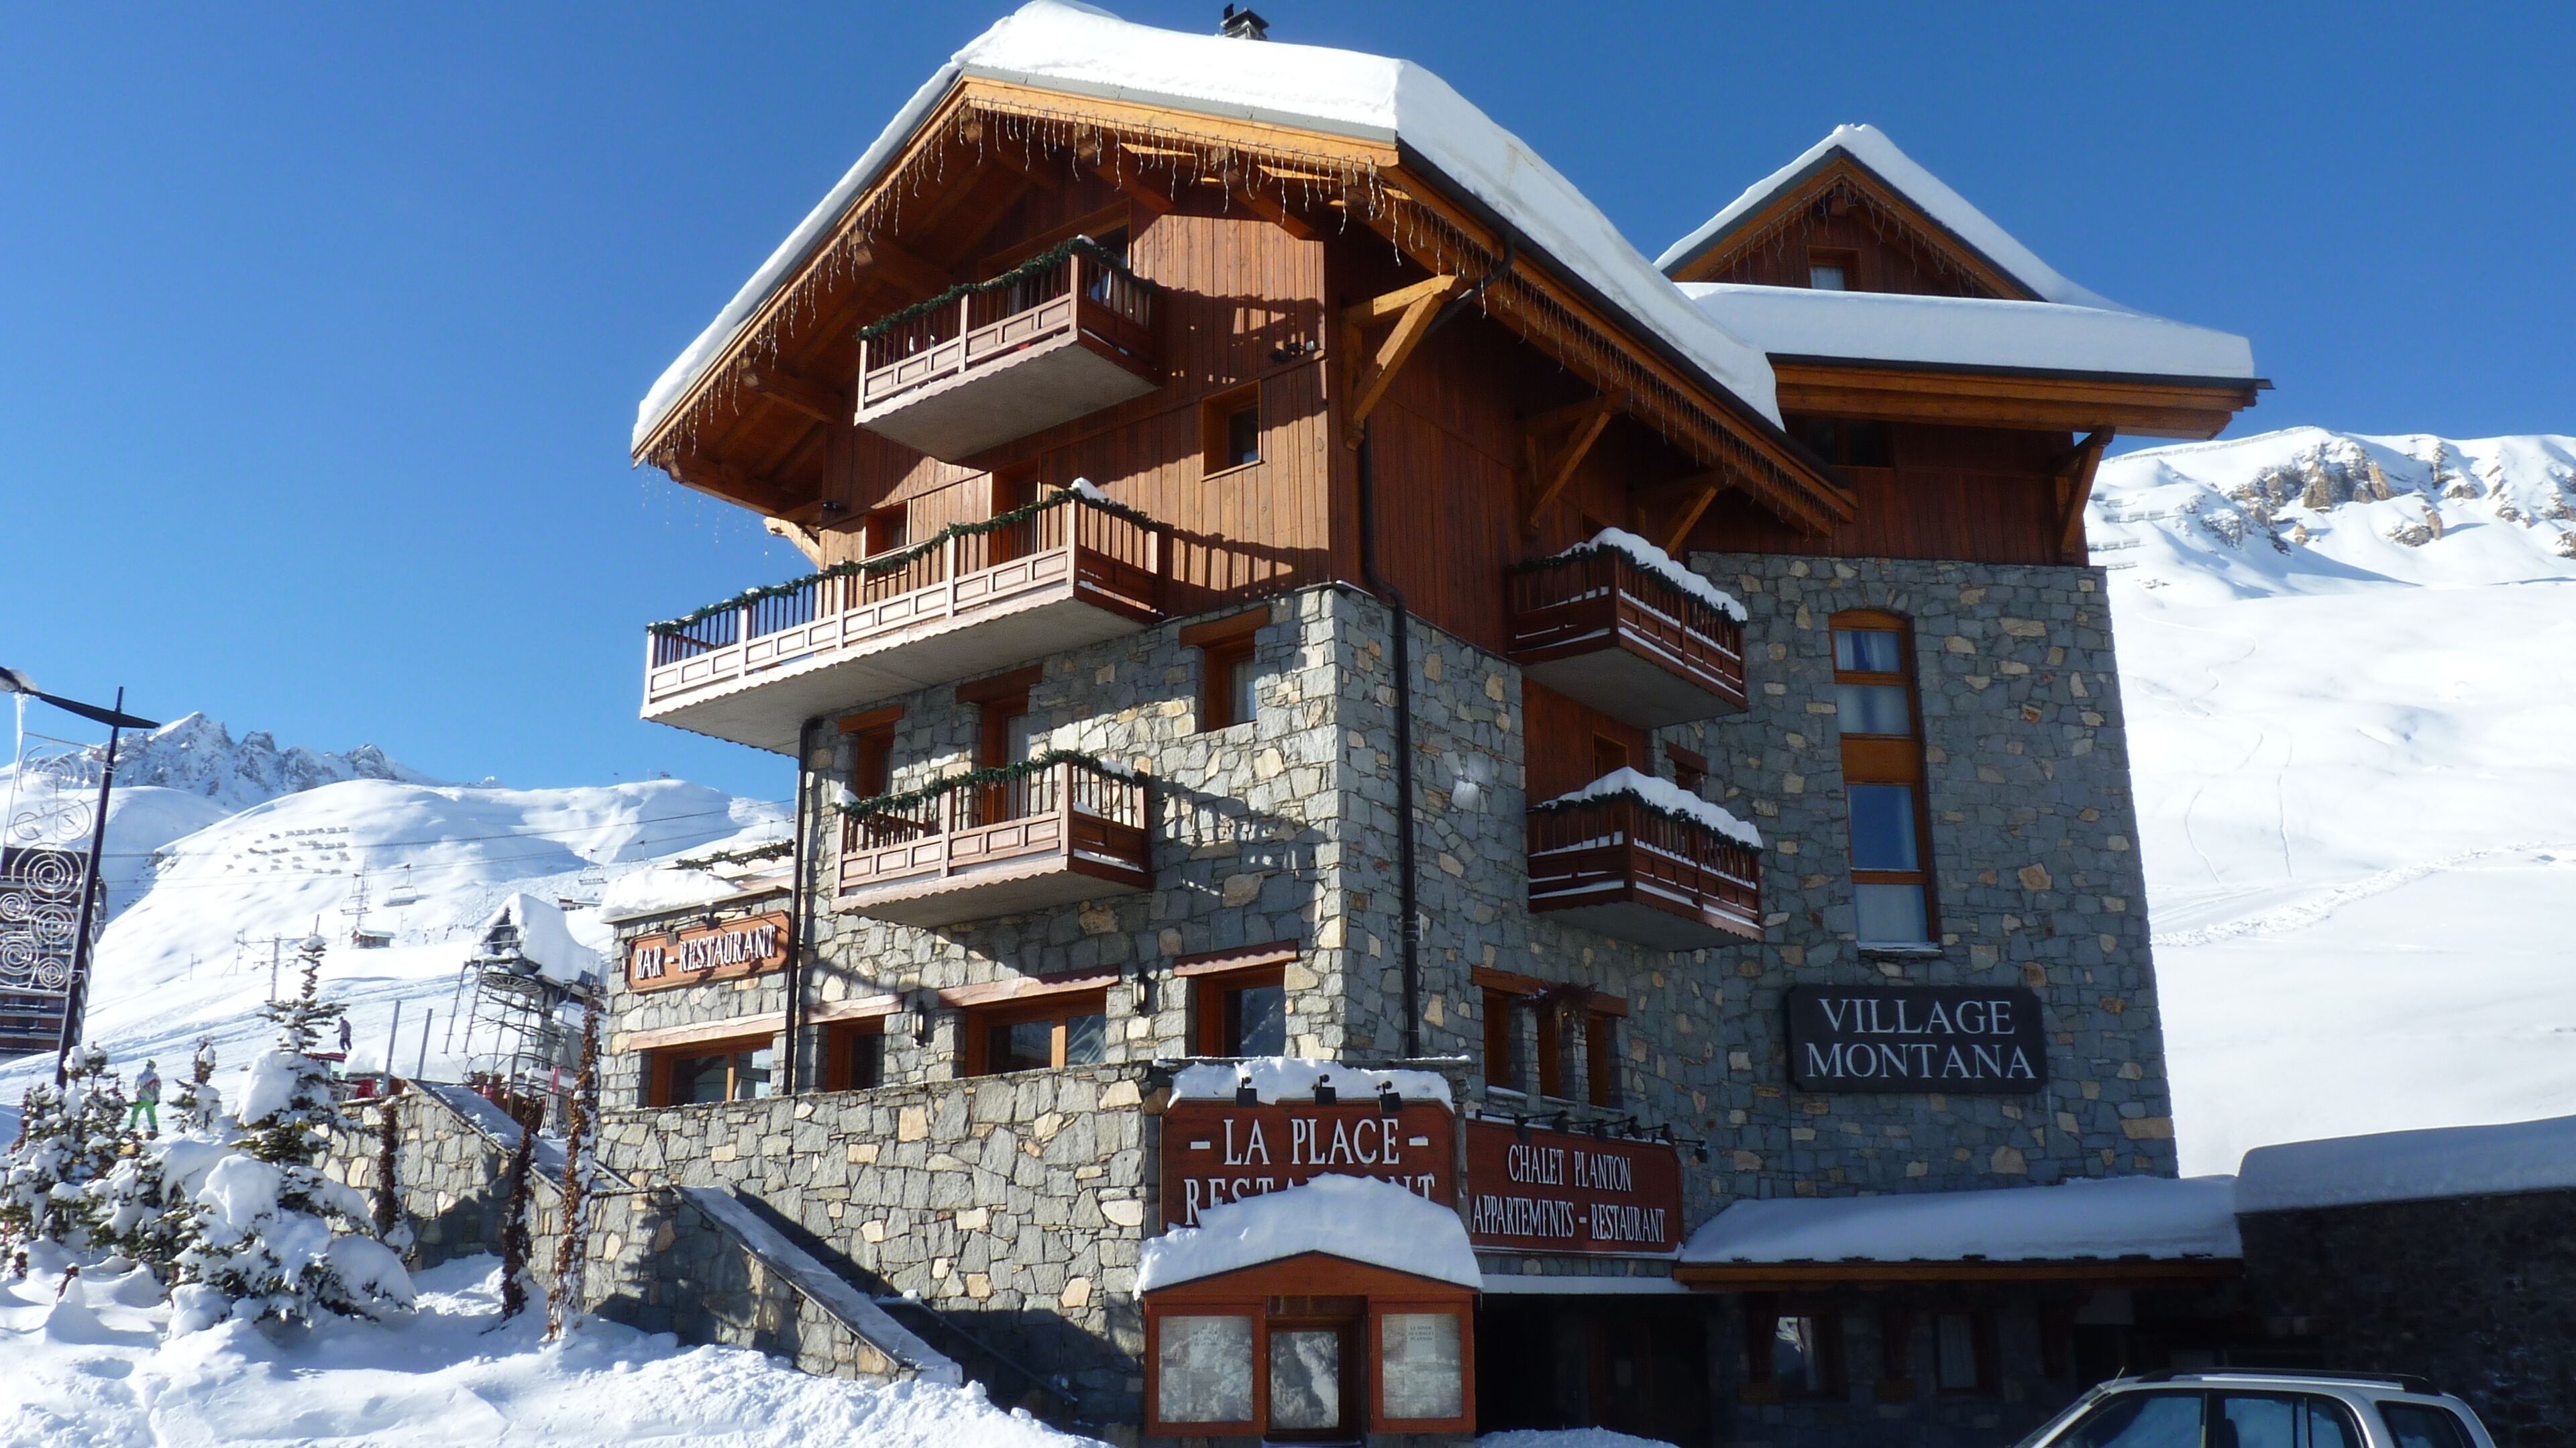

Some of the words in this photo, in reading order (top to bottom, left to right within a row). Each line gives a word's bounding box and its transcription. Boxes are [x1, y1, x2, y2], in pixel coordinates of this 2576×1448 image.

[635, 945, 661, 979] BAR
[678, 924, 775, 972] RESTAURANT
[1818, 998, 2015, 1035] VILLAGE
[1805, 1043, 2037, 1079] MONTANA
[1223, 1119, 1271, 1165] LA
[1291, 1119, 1400, 1165] PLACE
[1508, 1144, 1564, 1186] CHALET
[1574, 1150, 1632, 1192] PLANTON
[1591, 1204, 1666, 1243] RESTAURANT
